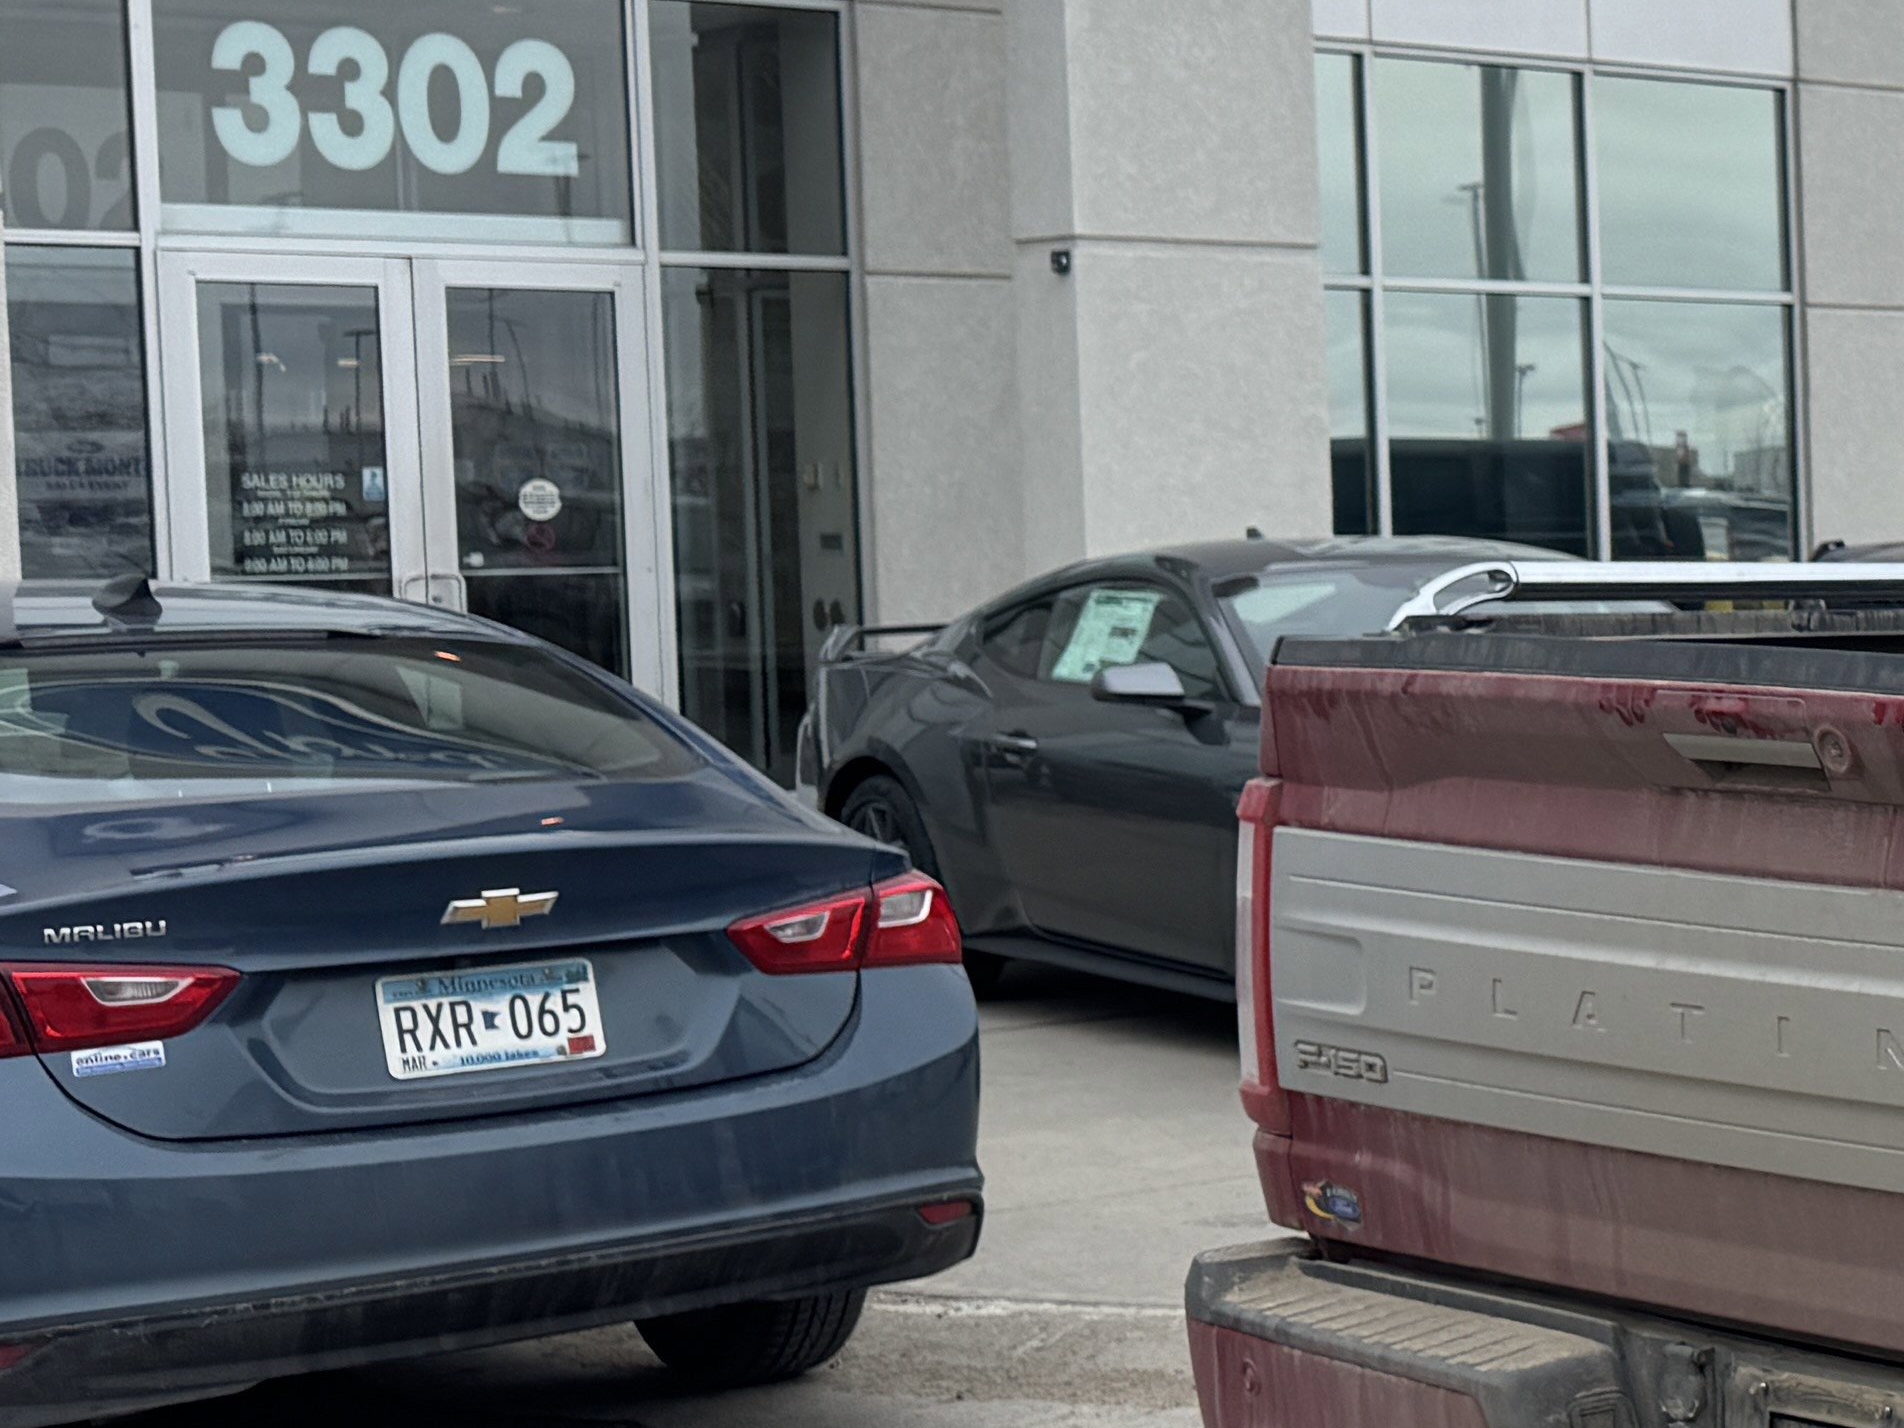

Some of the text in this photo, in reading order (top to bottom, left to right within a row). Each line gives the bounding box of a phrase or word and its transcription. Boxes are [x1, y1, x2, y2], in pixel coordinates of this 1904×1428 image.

[210, 19, 580, 178] 3302
[240, 472, 346, 490] SALES HOURS
[43, 920, 167, 945] MALIBU
[437, 972, 538, 996] Minnesota
[393, 987, 587, 1055] RXR 065
[401, 1054, 428, 1073] MAR
[1294, 1039, 1389, 1084] F-150
